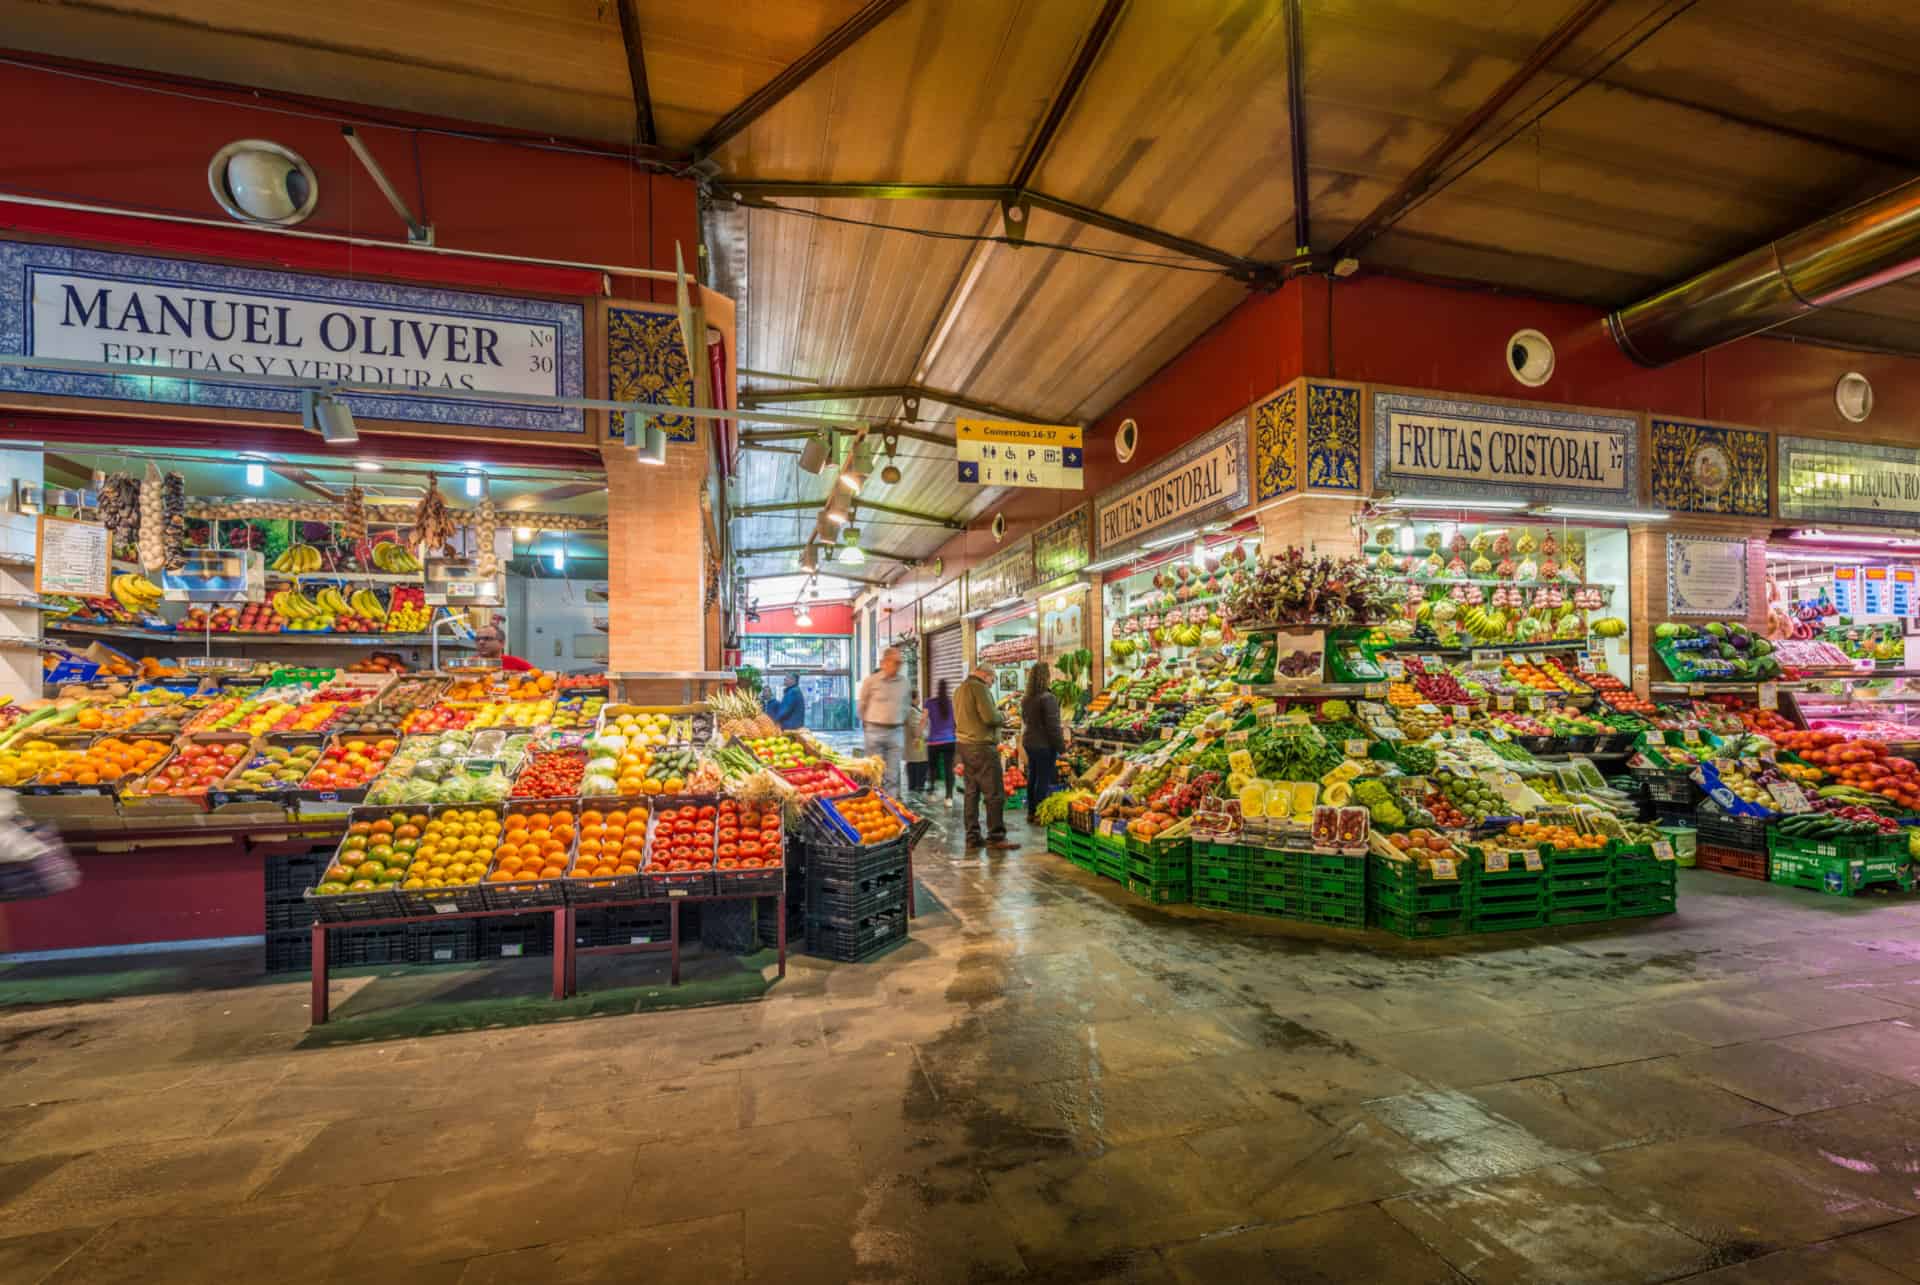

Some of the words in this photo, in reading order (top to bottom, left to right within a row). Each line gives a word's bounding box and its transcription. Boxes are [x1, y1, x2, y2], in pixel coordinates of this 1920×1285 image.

[60, 284, 303, 348] MANUEL
[319, 312, 503, 367] OLIVER
[101, 342, 245, 374] FRUTAS
[255, 356, 277, 376] Y
[285, 359, 475, 391] VERDURAS
[528, 355, 553, 374] 30
[1397, 423, 1483, 473] FRUTAS
[1488, 430, 1605, 482] CRISTOBAL
[1610, 453, 1623, 470] 17
[1103, 495, 1142, 543] FRUTAS
[1144, 457, 1222, 523] CRISTOBAL
